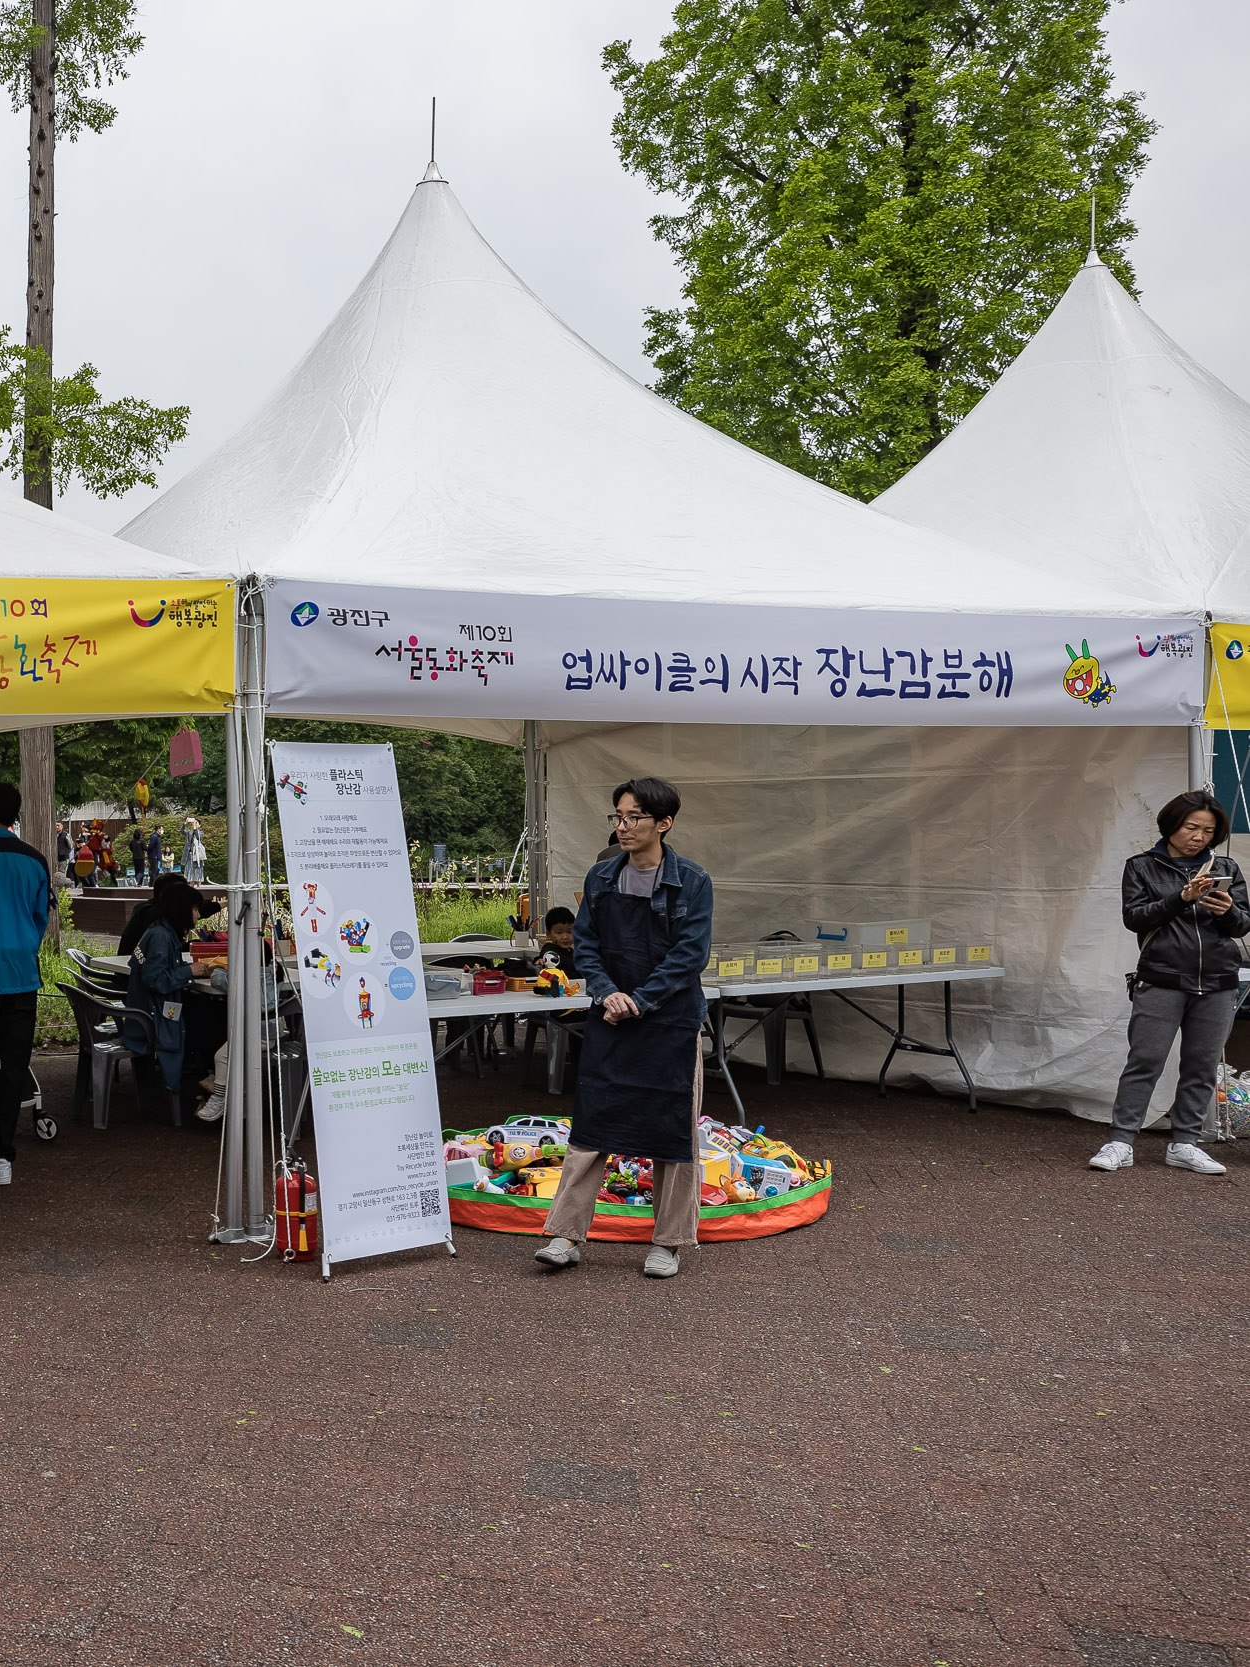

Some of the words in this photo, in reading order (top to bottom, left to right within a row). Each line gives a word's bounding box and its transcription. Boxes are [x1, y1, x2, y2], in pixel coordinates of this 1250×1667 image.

[168, 609, 218, 628] 행복광진
[326, 607, 391, 628] 광진구
[459, 624, 513, 642] 제10회
[1160, 642, 1193, 658] 행복광진
[374, 635, 514, 686] 서울동화축제
[562, 649, 730, 694] 업싸이클의
[740, 654, 803, 696] 시작
[816, 644, 1013, 699] 장난감분해
[290, 770, 308, 780] 우리가
[310, 770, 328, 780] 사랑한
[329, 768, 364, 781] 플라스틱
[336, 783, 361, 796] 장난감
[362, 786, 394, 794] 사용설명서
[312, 1066, 346, 1086] 쓸모없는
[348, 1065, 380, 1082] 장난감의
[382, 1060, 402, 1076] 모습
[402, 1060, 429, 1075] 대변신
